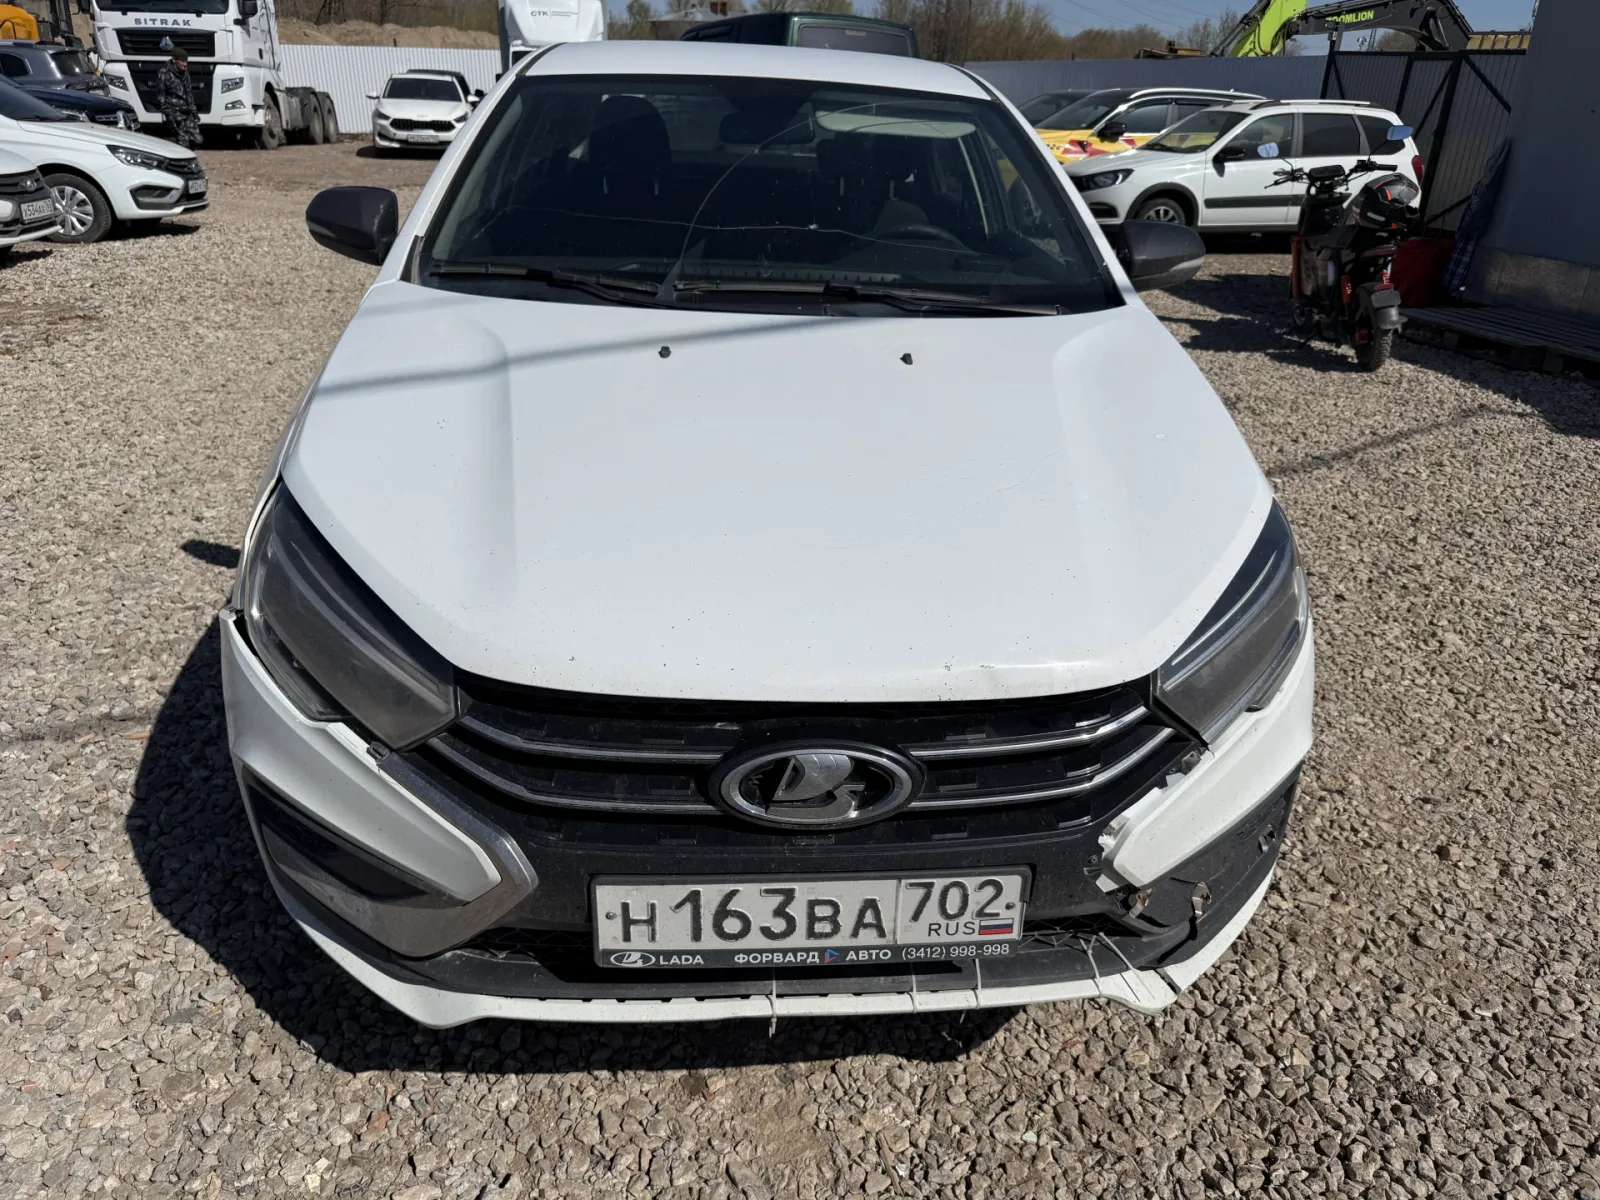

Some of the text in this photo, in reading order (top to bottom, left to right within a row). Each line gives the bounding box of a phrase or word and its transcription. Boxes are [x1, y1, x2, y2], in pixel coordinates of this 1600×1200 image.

[134, 17, 191, 26] SITRAK
[620, 878, 1005, 943] Н163ВА 702
[927, 921, 976, 937] RUS
[734, 949, 892, 964] ФОРВАРД АВТО
[901, 943, 1010, 960] (3412) 998-998
[659, 954, 704, 966] LADA
